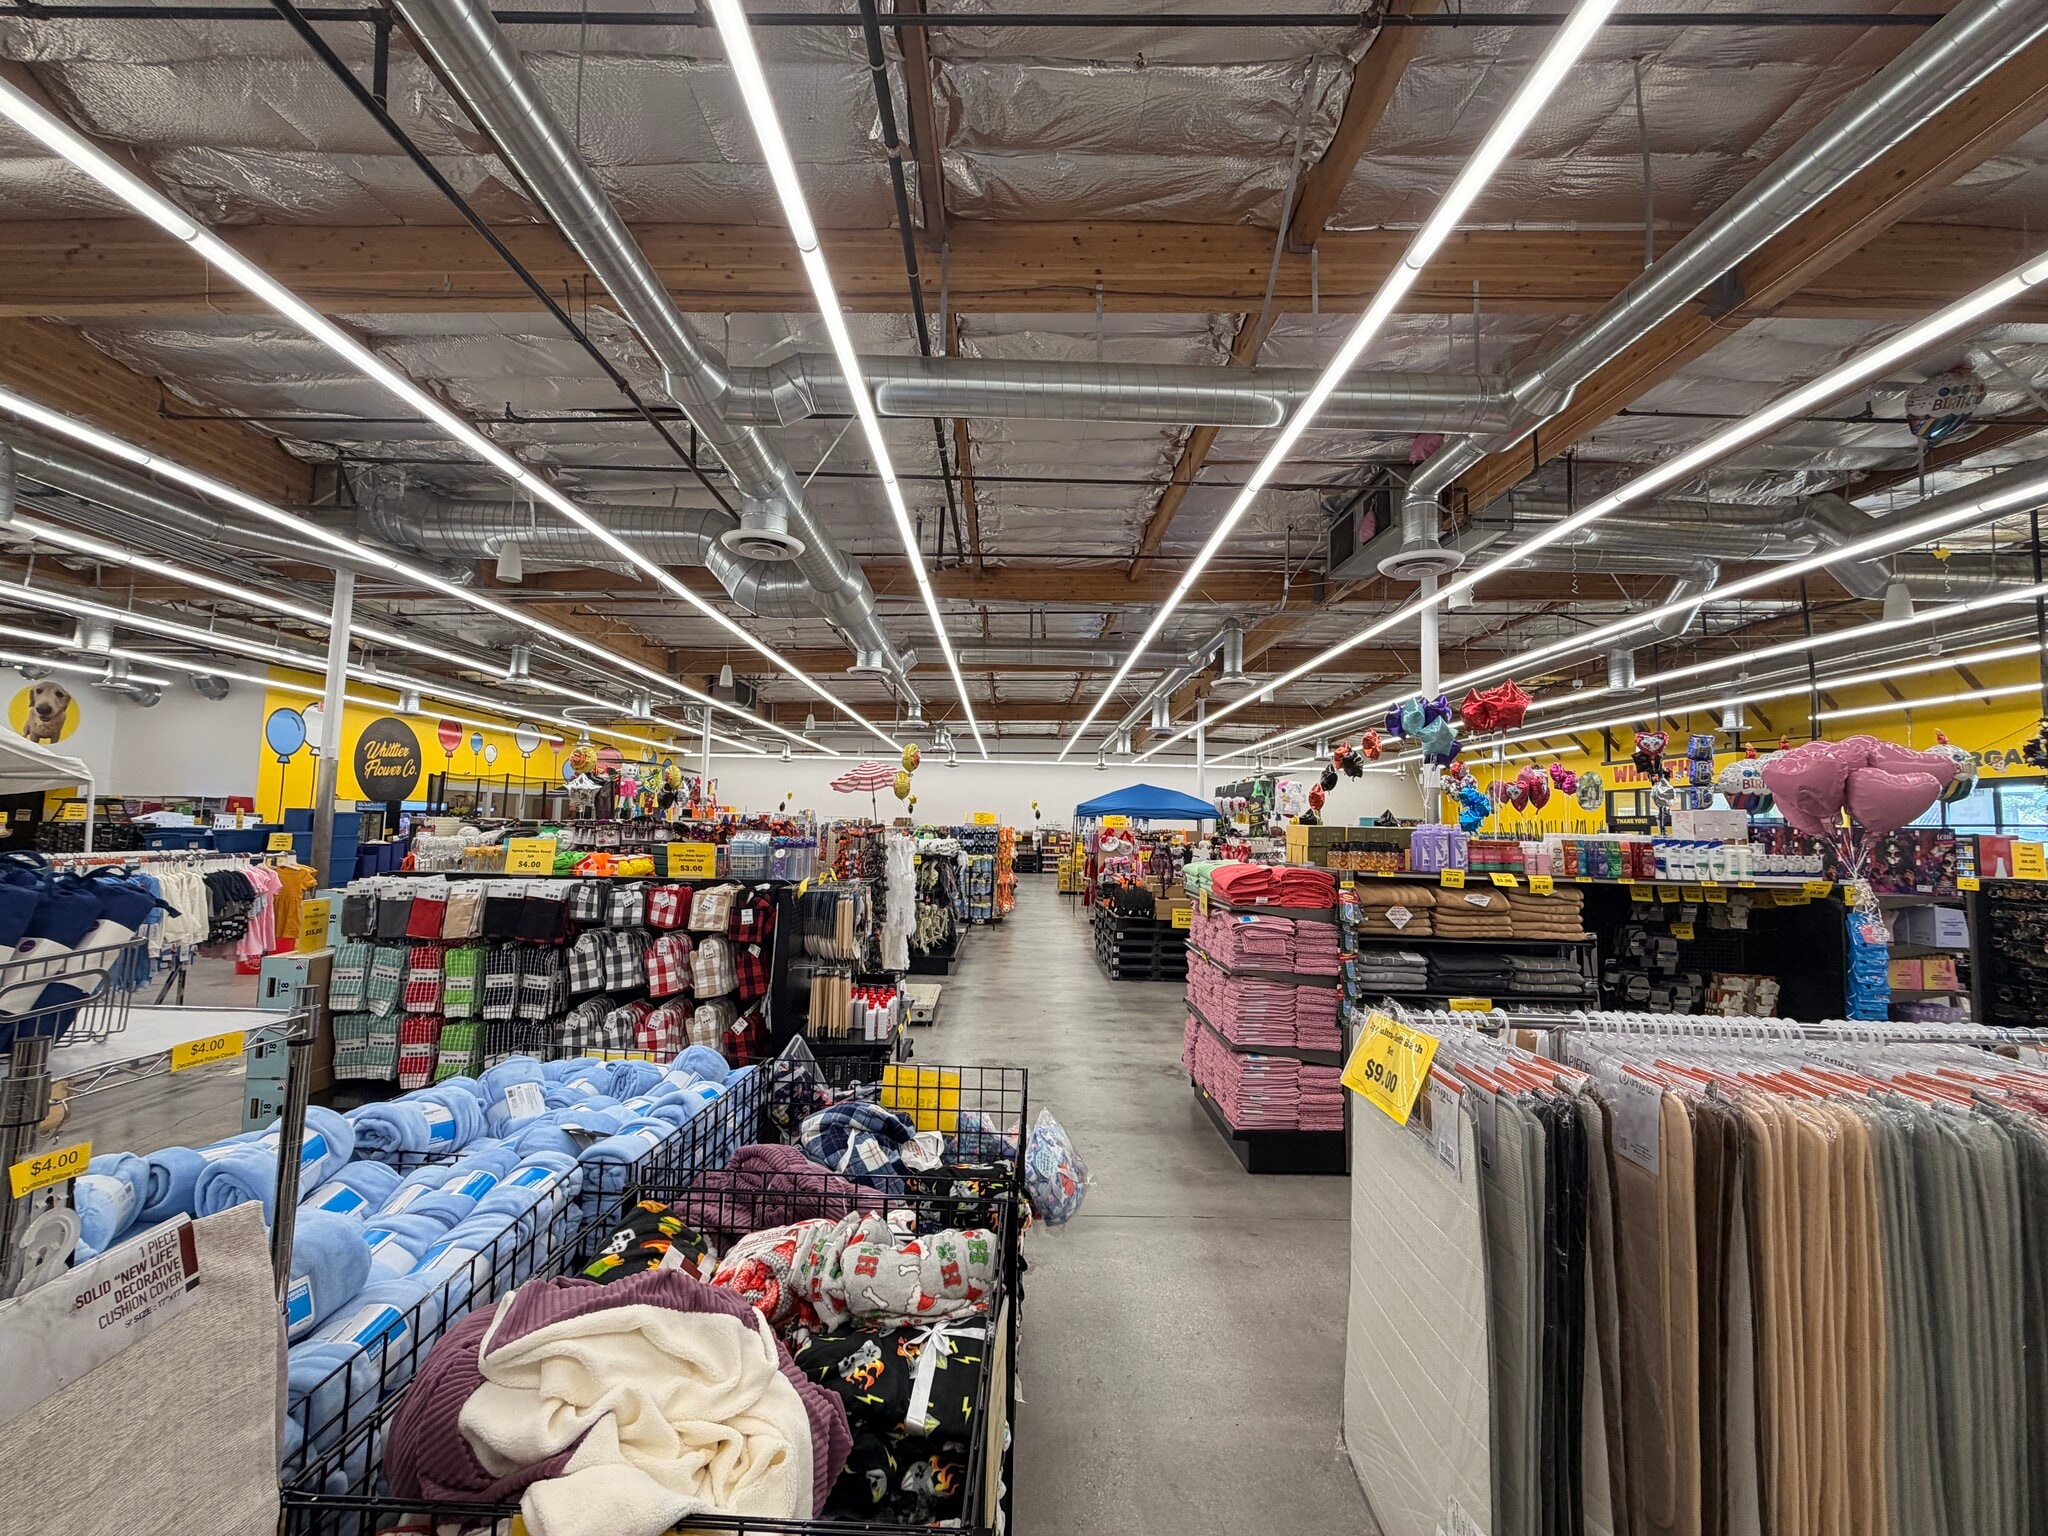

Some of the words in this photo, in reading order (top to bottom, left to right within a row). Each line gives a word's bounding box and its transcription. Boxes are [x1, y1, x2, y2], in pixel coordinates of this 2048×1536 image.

[364, 740, 409, 759] Whittier
[364, 759, 402, 779] Flower
[402, 759, 417, 778] Co.
[518, 860, 541, 868] $4.00
[305, 928, 322, 936] $15.00
[281, 982, 289, 993] 18
[190, 1038, 225, 1056] $4.00
[269, 1043, 277, 1053] 18
[1364, 1058, 1398, 1093] $9.00
[264, 1103, 271, 1114] 18
[31, 1151, 78, 1176] $4.00
[139, 1246, 145, 1257] 1
[147, 1229, 177, 1254] PIECE
[114, 1257, 180, 1304] DECORATIVE
[75, 1280, 111, 1309] SOLID
[98, 1291, 148, 1330] CUSHION
[149, 1271, 182, 1299] COVER
